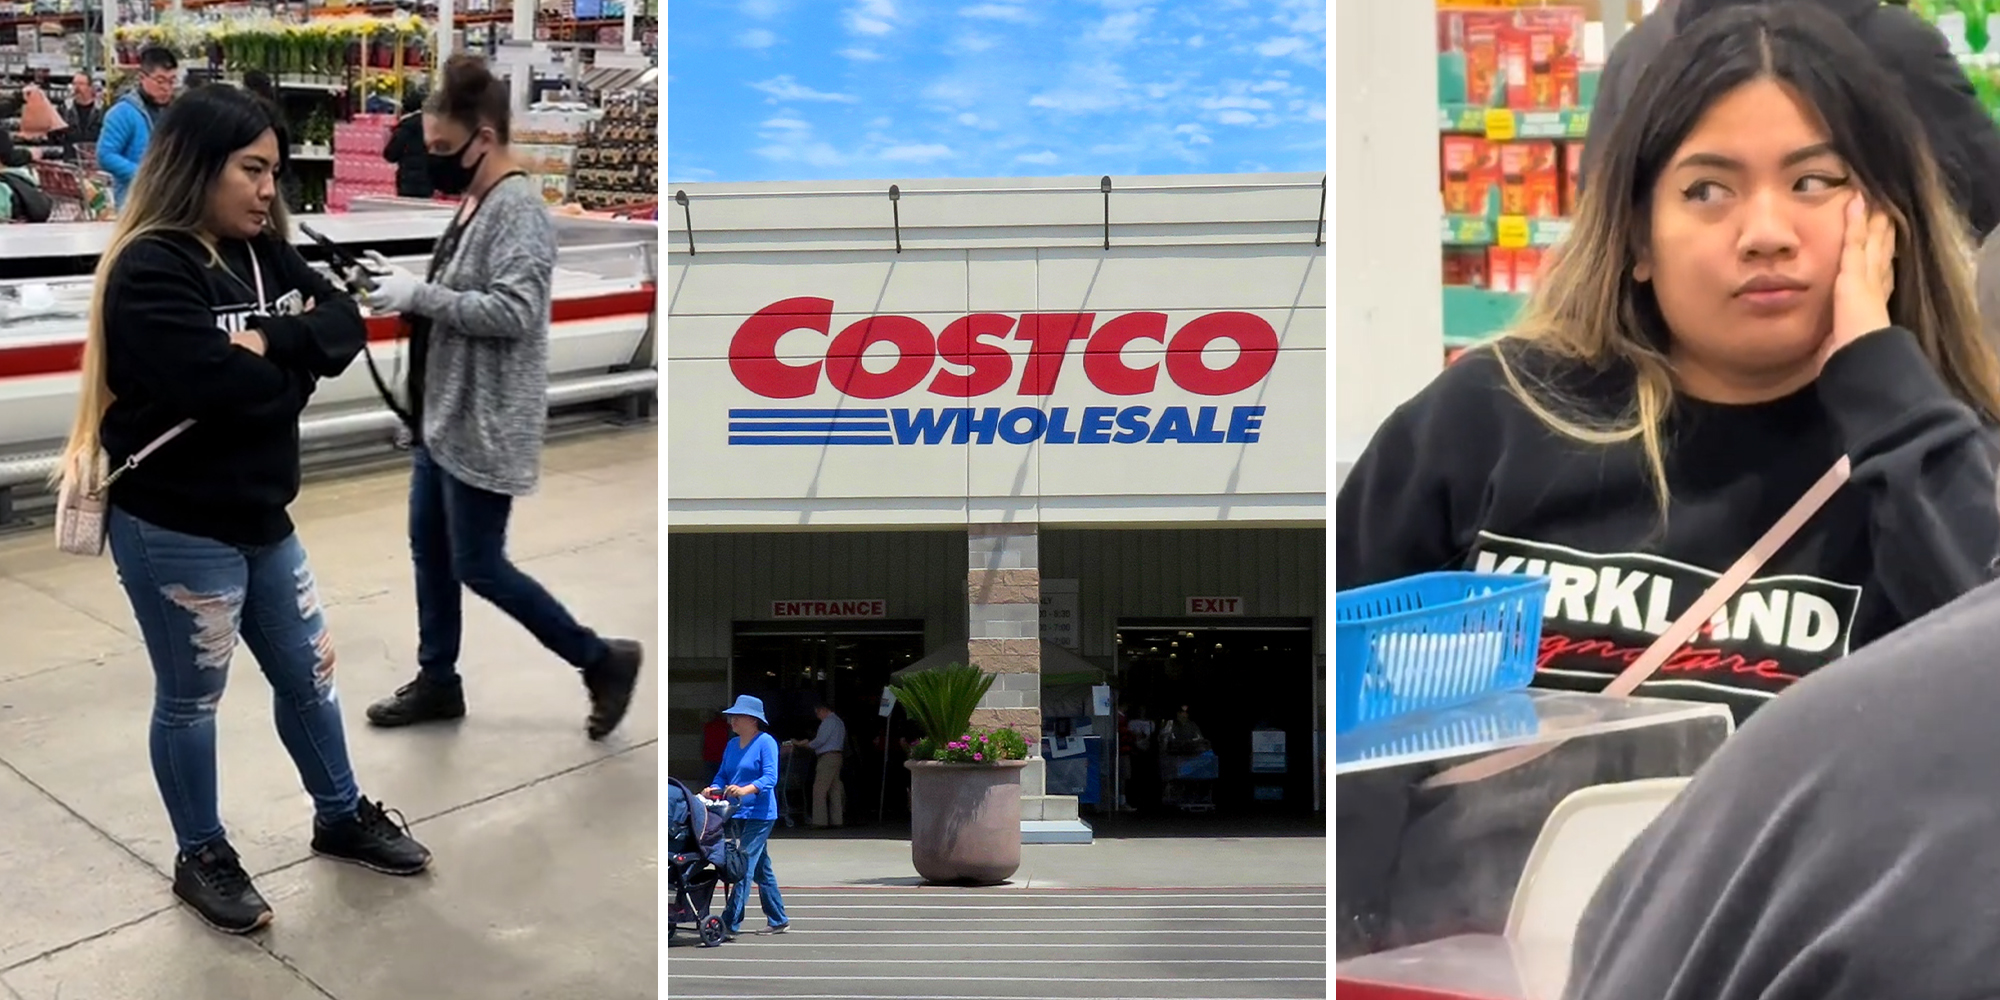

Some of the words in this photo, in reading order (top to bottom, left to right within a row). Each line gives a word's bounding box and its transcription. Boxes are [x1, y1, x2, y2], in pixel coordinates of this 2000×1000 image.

[728, 296, 1279, 399] COSTCO
[890, 406, 1266, 445] WHOLESALE
[774, 601, 883, 616] ENTRANCE
[1191, 598, 1239, 613] EXIT
[1475, 550, 1840, 653] RKLND
